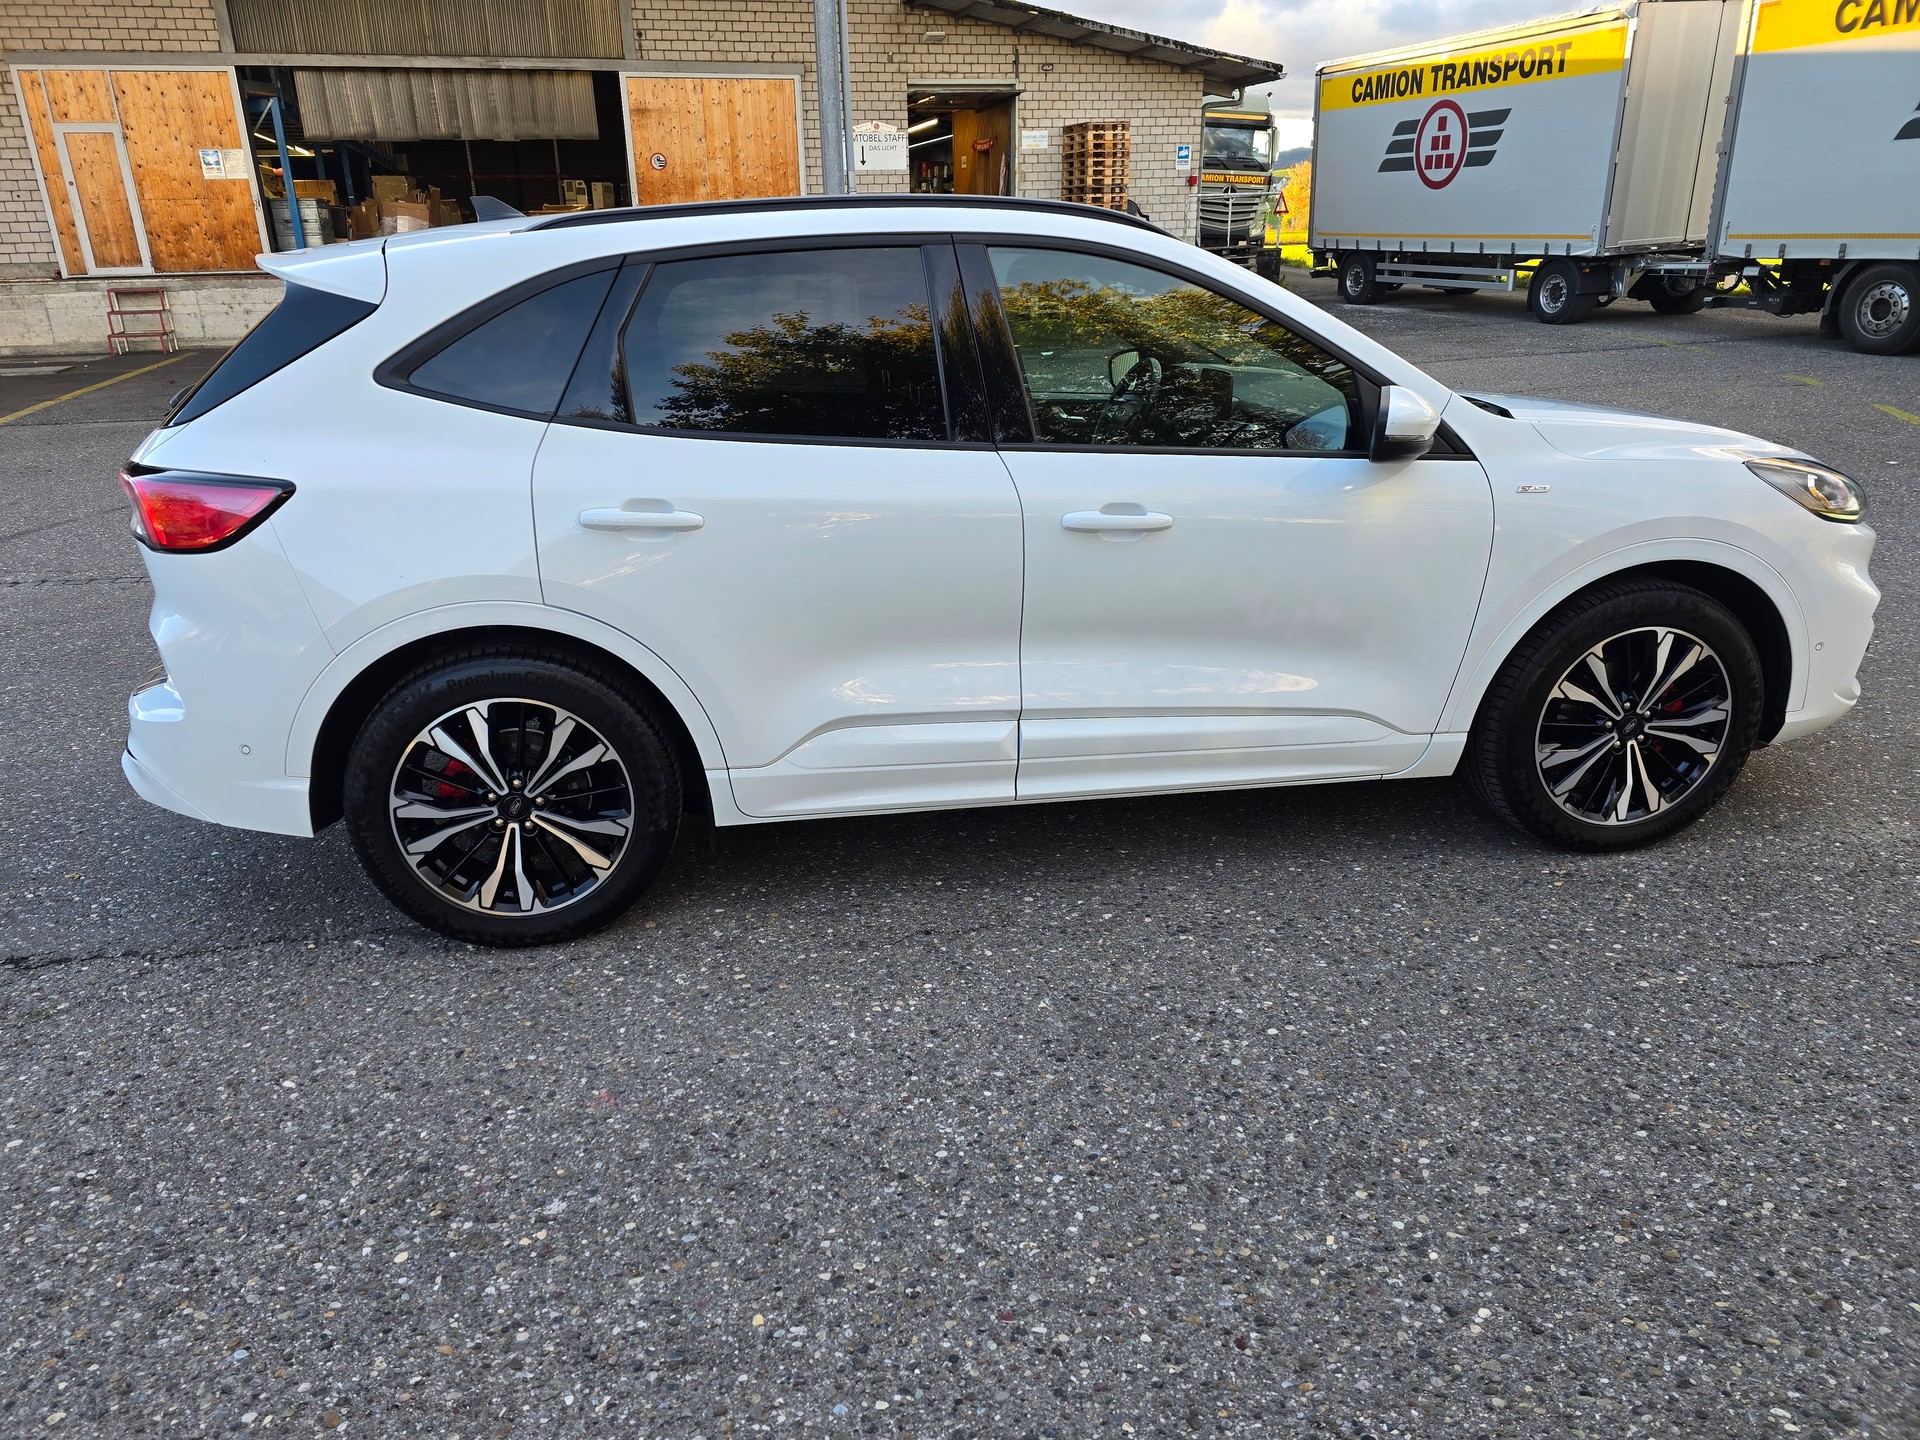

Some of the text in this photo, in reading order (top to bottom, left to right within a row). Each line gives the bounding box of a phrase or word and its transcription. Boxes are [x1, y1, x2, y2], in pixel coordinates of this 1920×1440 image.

[1351, 41, 1573, 103] CAMION TRANSPORT
[841, 133, 905, 142] ZMTOBEL STAFF
[1201, 174, 1265, 184] AMION TRANSPORT
